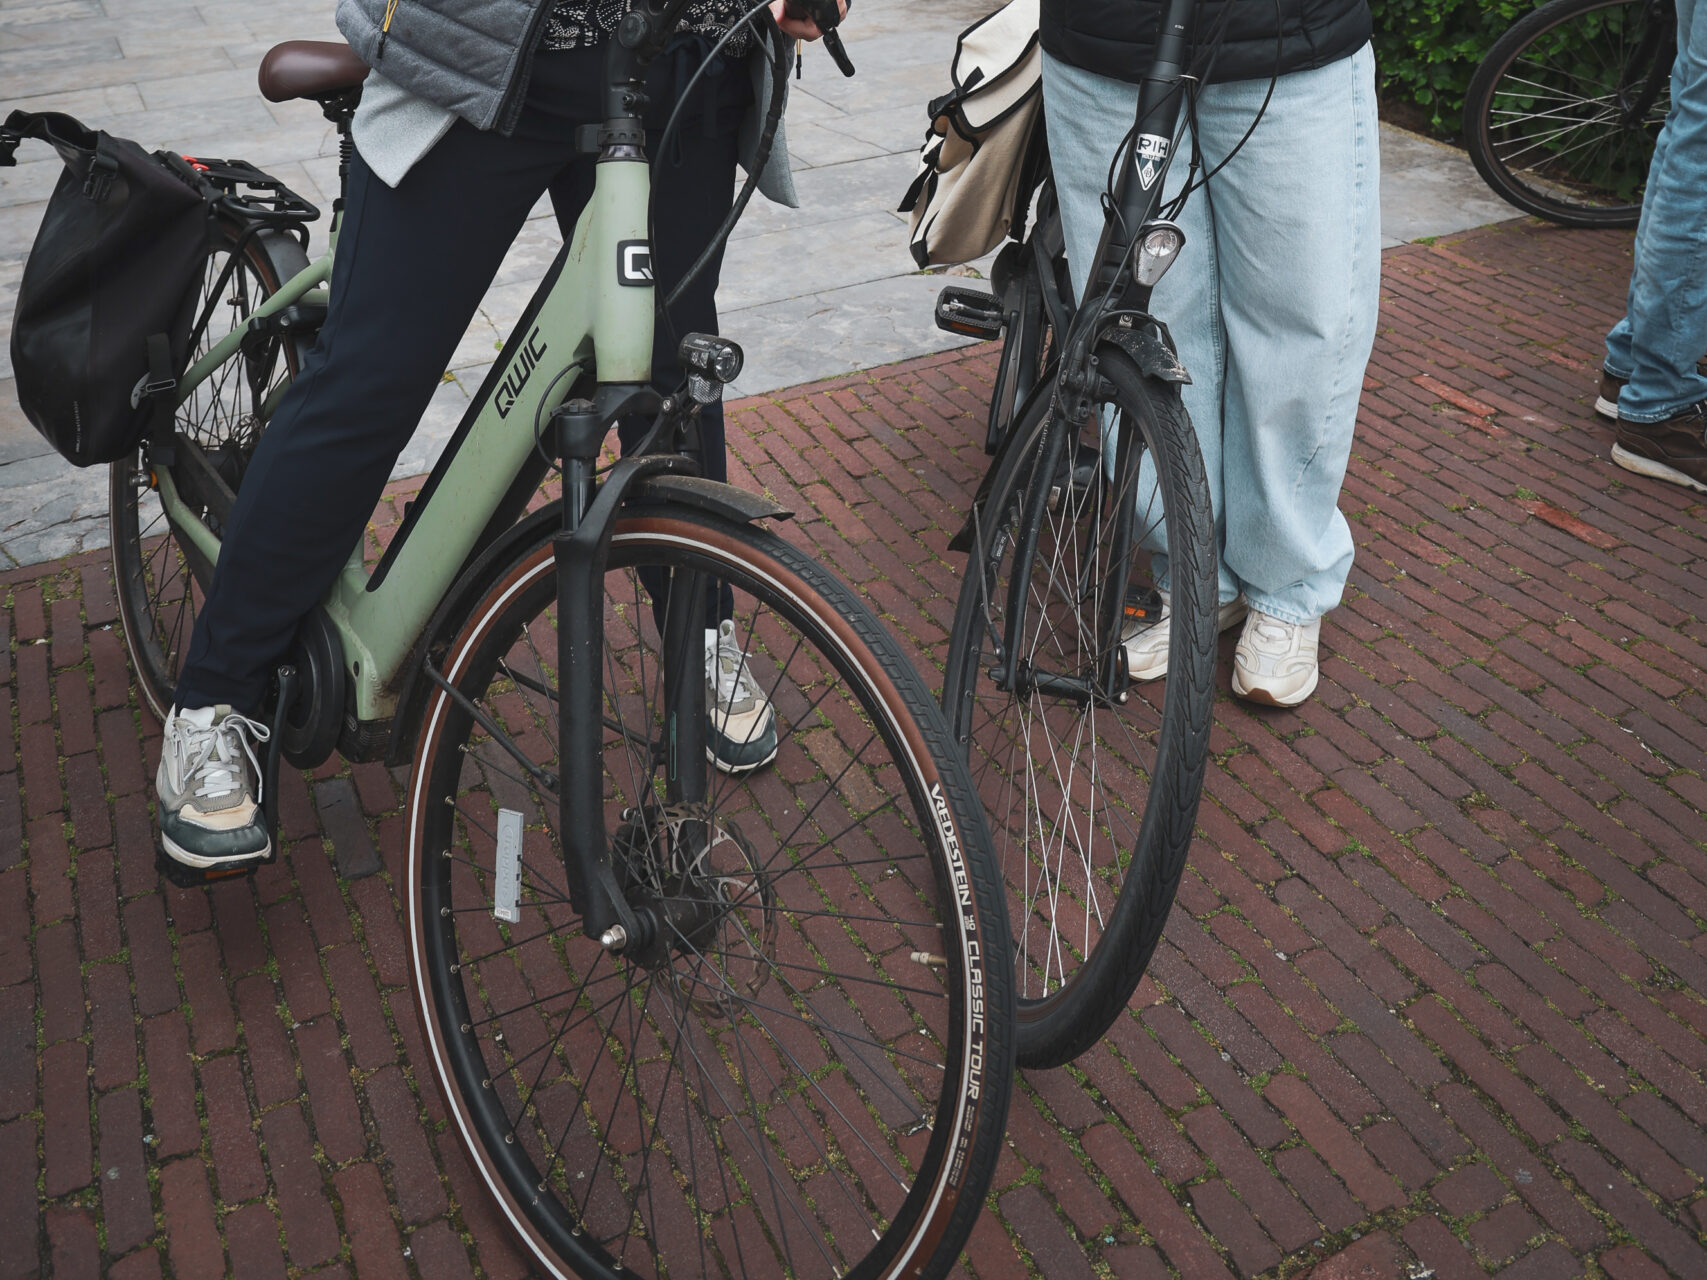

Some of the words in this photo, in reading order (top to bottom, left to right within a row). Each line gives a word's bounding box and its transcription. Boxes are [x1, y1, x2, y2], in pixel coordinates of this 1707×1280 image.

[1138, 136, 1168, 156] RIH
[494, 325, 548, 420] QWIC
[930, 782, 972, 906] VREDESTEIN
[967, 940, 984, 1035] CLASSIC
[967, 1040, 984, 1100] TOUR
